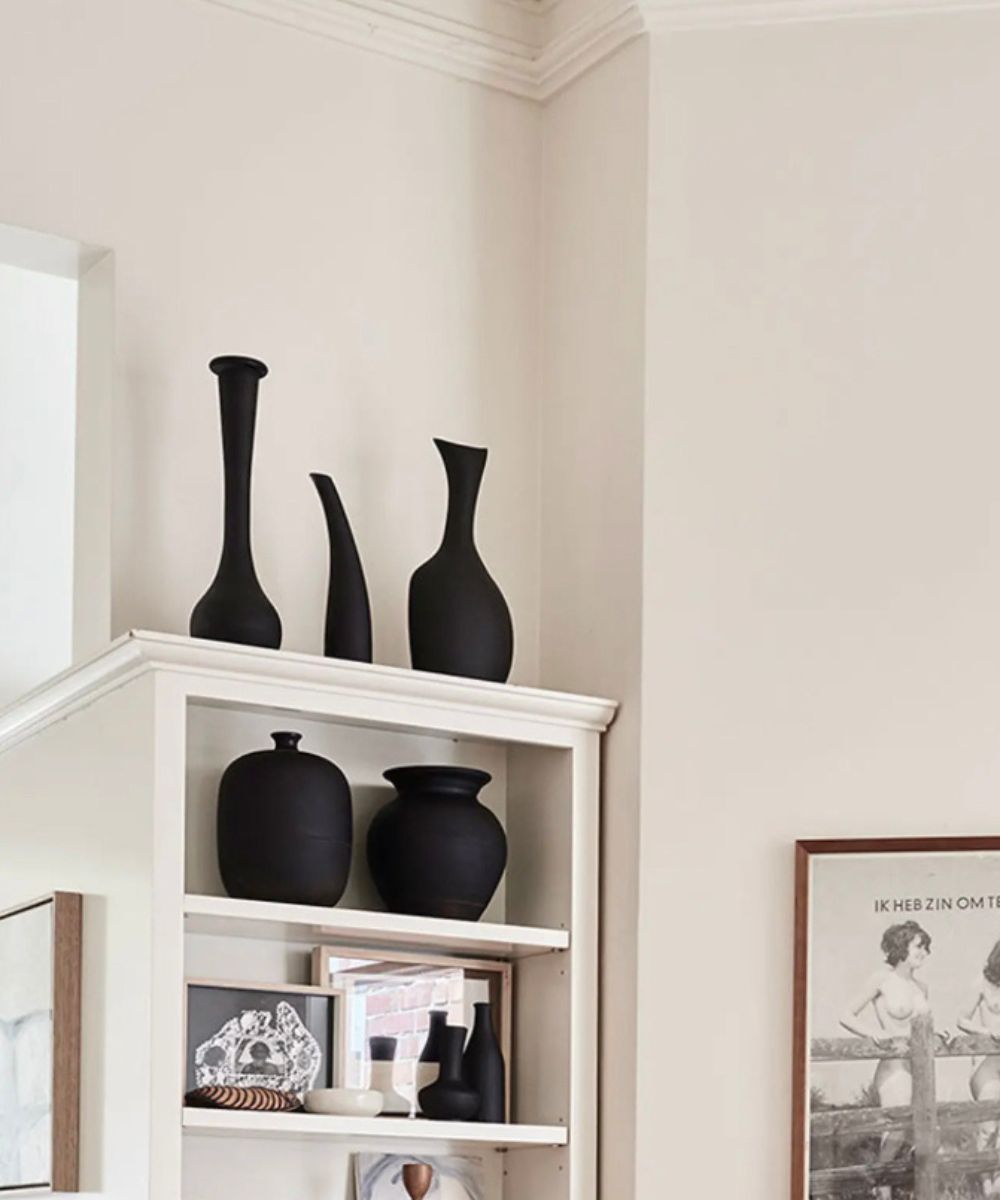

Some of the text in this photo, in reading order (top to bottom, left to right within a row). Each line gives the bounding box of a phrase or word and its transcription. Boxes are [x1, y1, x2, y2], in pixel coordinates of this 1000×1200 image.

[874, 900, 889, 913] IK
[892, 899, 923, 912] HEB
[925, 898, 953, 911] ZIN
[955, 896, 985, 910] OM
